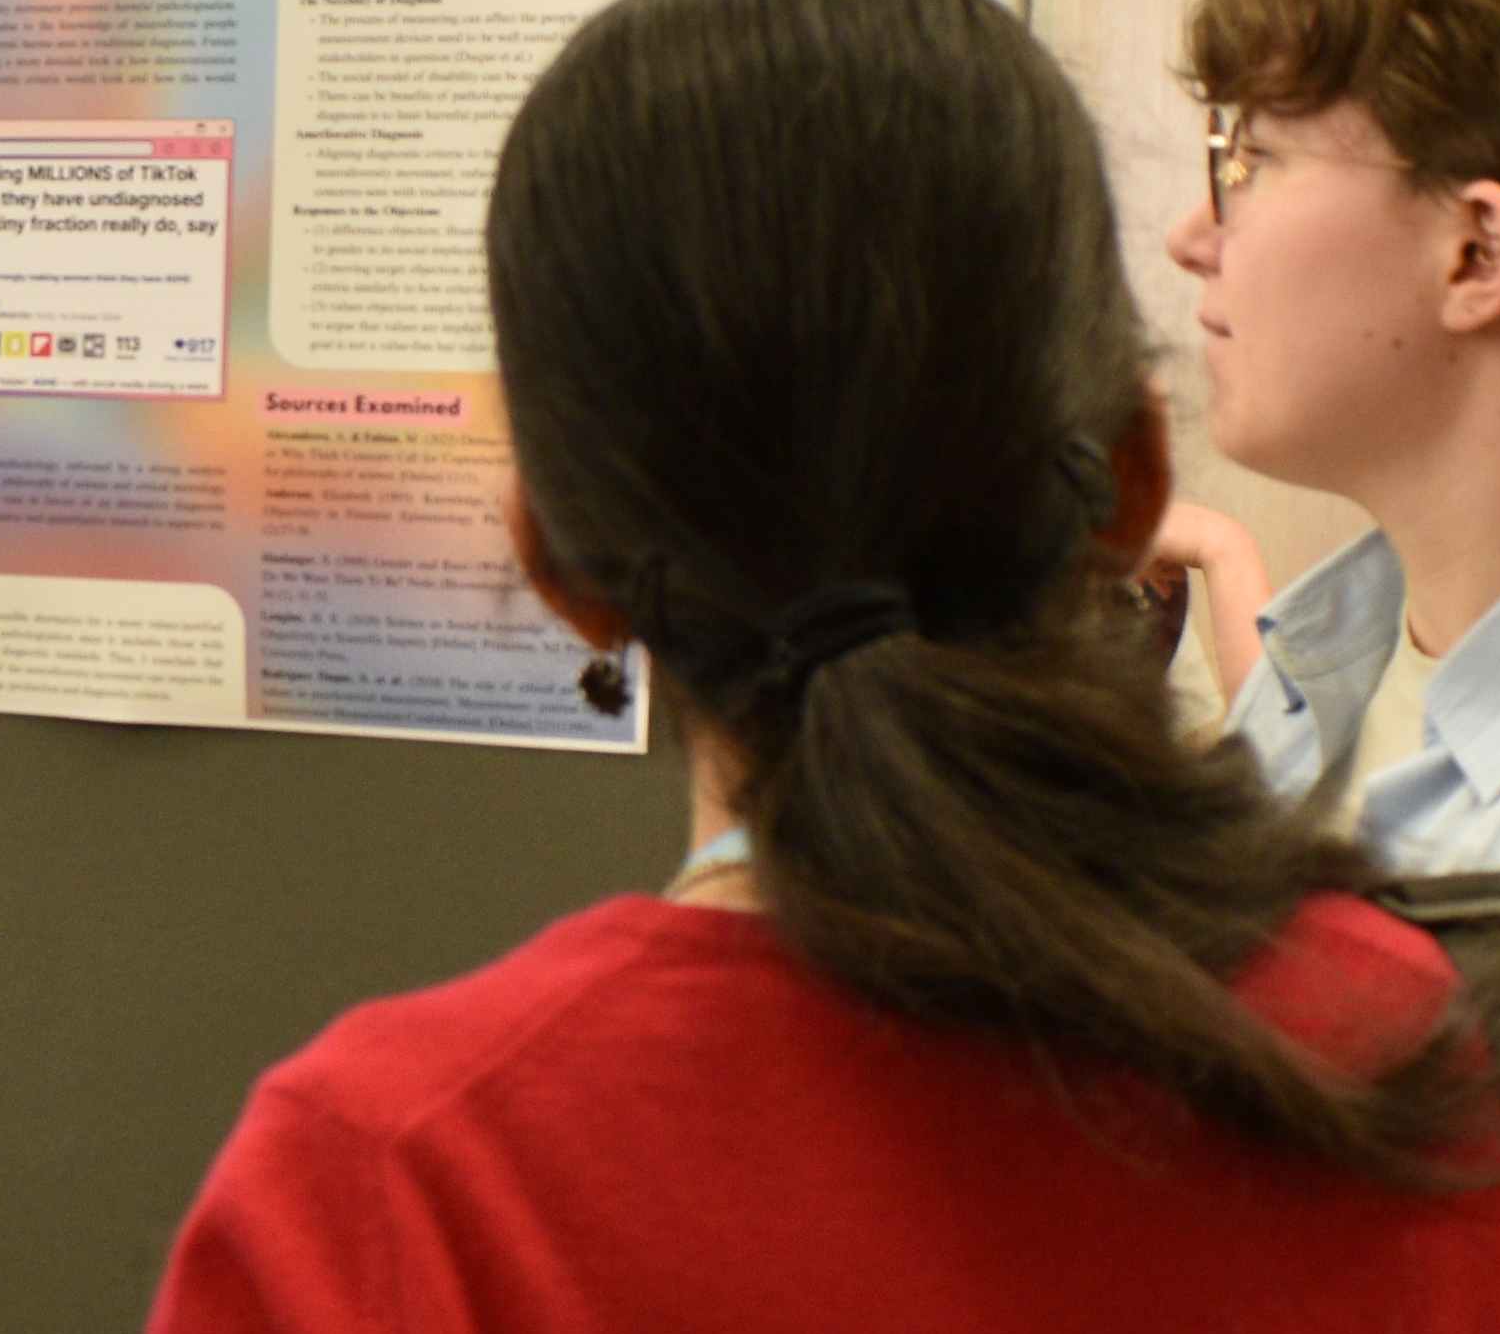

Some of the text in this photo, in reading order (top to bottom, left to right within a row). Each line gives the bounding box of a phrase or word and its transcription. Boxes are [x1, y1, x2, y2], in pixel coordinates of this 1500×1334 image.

[28, 166, 112, 182] MILLIONS
[117, 165, 135, 182] of
[140, 165, 197, 182] TikTok
[1, 191, 37, 210] they
[42, 192, 84, 206] have
[89, 191, 204, 210] undiagnosed
[30, 216, 97, 232] fraction
[101, 217, 150, 236] really
[154, 217, 182, 236] do,
[187, 220, 218, 236] say
[116, 336, 141, 351] 113
[266, 392, 461, 417] Sources Examined
